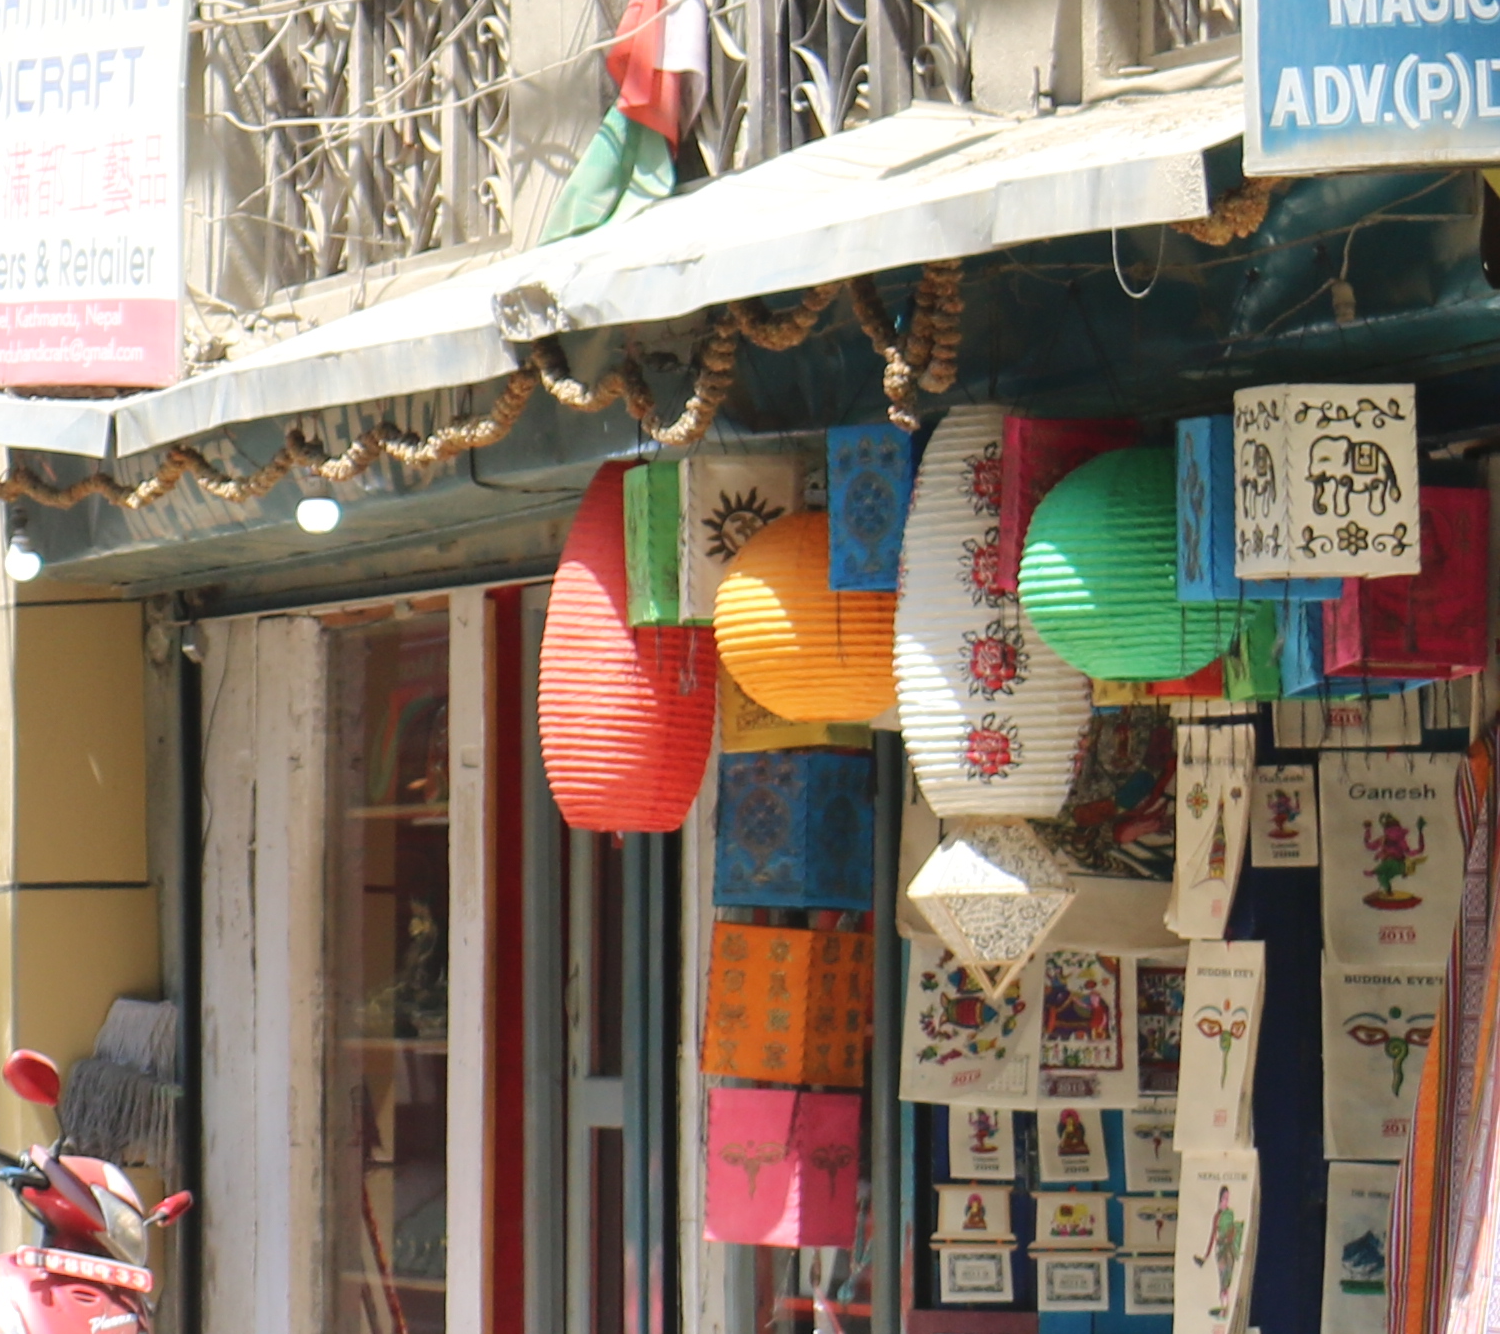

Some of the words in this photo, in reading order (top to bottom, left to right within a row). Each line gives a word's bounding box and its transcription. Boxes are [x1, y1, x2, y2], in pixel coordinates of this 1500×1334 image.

[35, 241, 49, 282] &
[59, 237, 154, 285] Retailer
[1348, 784, 1437, 801] Ganesh
[1378, 929, 1415, 942] 2019
[1345, 974, 1400, 985] BUDDHA
